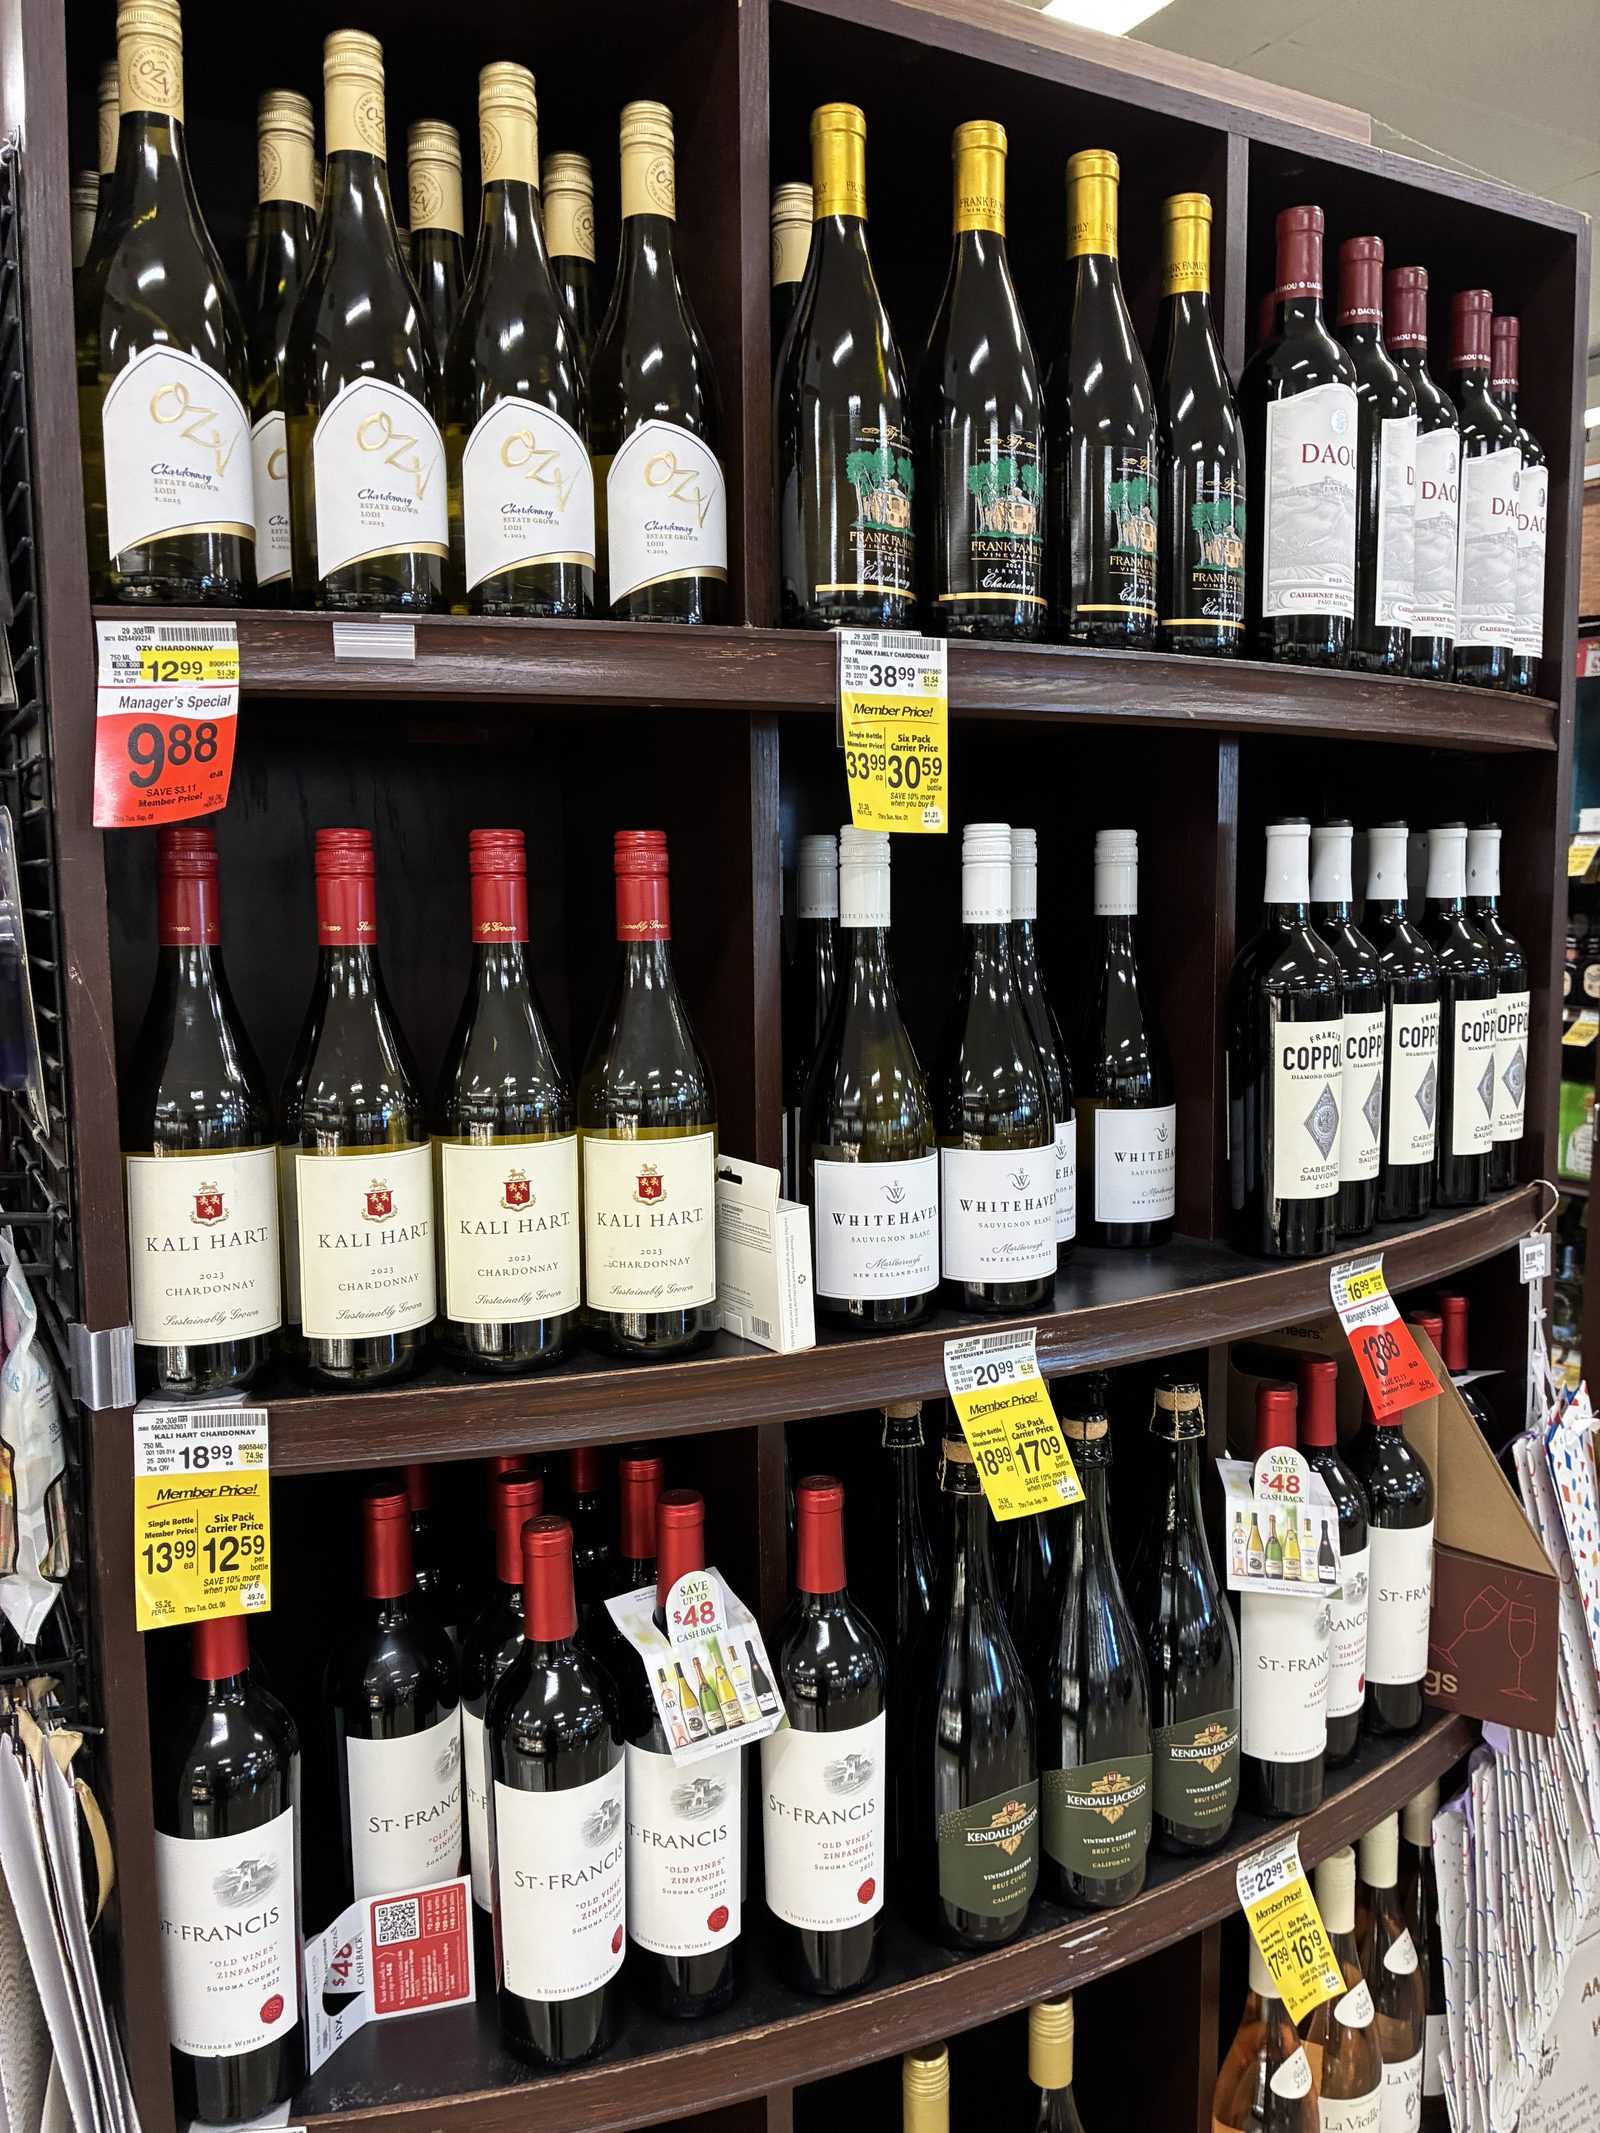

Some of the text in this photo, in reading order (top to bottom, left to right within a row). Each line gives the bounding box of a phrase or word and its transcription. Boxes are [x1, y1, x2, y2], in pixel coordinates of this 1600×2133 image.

[150, 381, 243, 477] OZV
[356, 411, 439, 500] OZV
[151, 463, 212, 483] Chardonnay
[501, 428, 583, 512] OZV
[154, 478, 187, 488] ESTATE
[643, 450, 718, 528] OZV
[357, 488, 413, 505] Chardonnay
[360, 503, 391, 511] ESTATE
[500, 503, 553, 518] Chardonnay
[503, 516, 531, 524] ESTATE
[644, 520, 693, 535] Chardonnay
[849, 531, 889, 543] FRANK
[971, 541, 1012, 552] FRANK
[1289, 591, 1333, 600] CABERNET
[894, 652, 930, 660] CHARDONNAY
[190, 695, 231, 710] Special
[853, 703, 934, 718] Member Price!
[898, 734, 931, 743] Six Pack
[891, 743, 939, 752] Carrier Price
[209, 770, 223, 779] ea
[147, 784, 196, 797] SAVE $3.11
[138, 797, 175, 807] Member
[178, 792, 203, 804] Price!
[1309, 1031, 1341, 1044] FRANCIS
[1302, 1162, 1338, 1174] CABERNET
[460, 1220, 509, 1235] KALI
[597, 1212, 640, 1228] KALI
[978, 1220, 1031, 1229] SAUVIGNON
[146, 1235, 199, 1252] KALI
[318, 1233, 370, 1249] KALI
[851, 1229, 931, 1243] SAUVIGNON BLANC
[640, 1248, 663, 1256] 2023
[992, 1239, 1045, 1254] Marlborough
[508, 1254, 531, 1263] 2023
[612, 1256, 691, 1269] CHARDONNAY
[865, 1254, 923, 1270] Marlborough
[199, 1271, 225, 1280] 2023
[371, 1266, 394, 1275] 2023
[477, 1261, 559, 1277] CHARDONNAY
[166, 1279, 256, 1297] CHARDONNAY
[338, 1272, 419, 1292] CHARDONNAY
[475, 1288, 562, 1306] Sustainably Grown
[610, 1282, 694, 1298] Sustainably Grown
[335, 1300, 423, 1321] Sustainably Grown
[1370, 1300, 1390, 1315] Special
[163, 1308, 260, 1327] Sustainably Grown
[950, 1350, 984, 1361] WHITEHAVEN
[985, 1345, 1014, 1354] SAUVIGNON
[969, 1392, 1038, 1415] Member Price!
[1015, 1417, 1045, 1430] Six Pack
[200, 1429, 256, 1438] CHARDONNAY
[1011, 1425, 1054, 1440] Carrier Price
[1271, 1455, 1298, 1466] SAVE
[1025, 1470, 1067, 1485] SAVE more
[1261, 1473, 1300, 1494] $48
[156, 1484, 258, 1501] Member Price!
[1260, 1493, 1305, 1504] CASH BACK
[147, 1517, 194, 1528] Single Bottle
[214, 1512, 255, 1523] Six Pack
[144, 1527, 197, 1540] Member Price!
[205, 1522, 264, 1534] Carrier Price
[184, 1561, 194, 1570] ea
[250, 1563, 268, 1571] bottle
[254, 1556, 265, 1564] per
[203, 1574, 261, 1587] SAVE 10% more
[203, 1582, 252, 1594] when you buy
[680, 1580, 709, 1597] SAVE
[682, 1592, 708, 1606] UP TO
[673, 1600, 715, 1628] $48
[676, 1623, 723, 1643] CASH BACK
[665, 1700, 678, 1709] AIX
[1171, 1734, 1239, 1758] KENDALL-JACKSON
[1067, 1782, 1146, 1807] KENDALL-JACKSON
[1193, 1803, 1227, 1817] CALIFORNIA
[967, 1807, 1039, 1843] KENDALL-JACKSON
[823, 1841, 874, 1860] ZINFANDEL
[814, 1862, 846, 1871] SONOMA
[1092, 1856, 1131, 1869] CALIFORNIA
[671, 1868, 726, 1885] ZINFANDEL
[662, 1879, 727, 1895] SONOMA COUNTY
[992, 1886, 1027, 1905] CALIFORNIA
[1256, 1888, 1303, 1923] Member Price!
[1302, 1918, 1317, 1931] Price
[216, 1954, 279, 1979] ZINFANDEL
[354, 1937, 365, 1985] CASH BACK
[207, 1966, 281, 1992] SONOMA COUNTY
[334, 2015, 343, 2041] AIX
